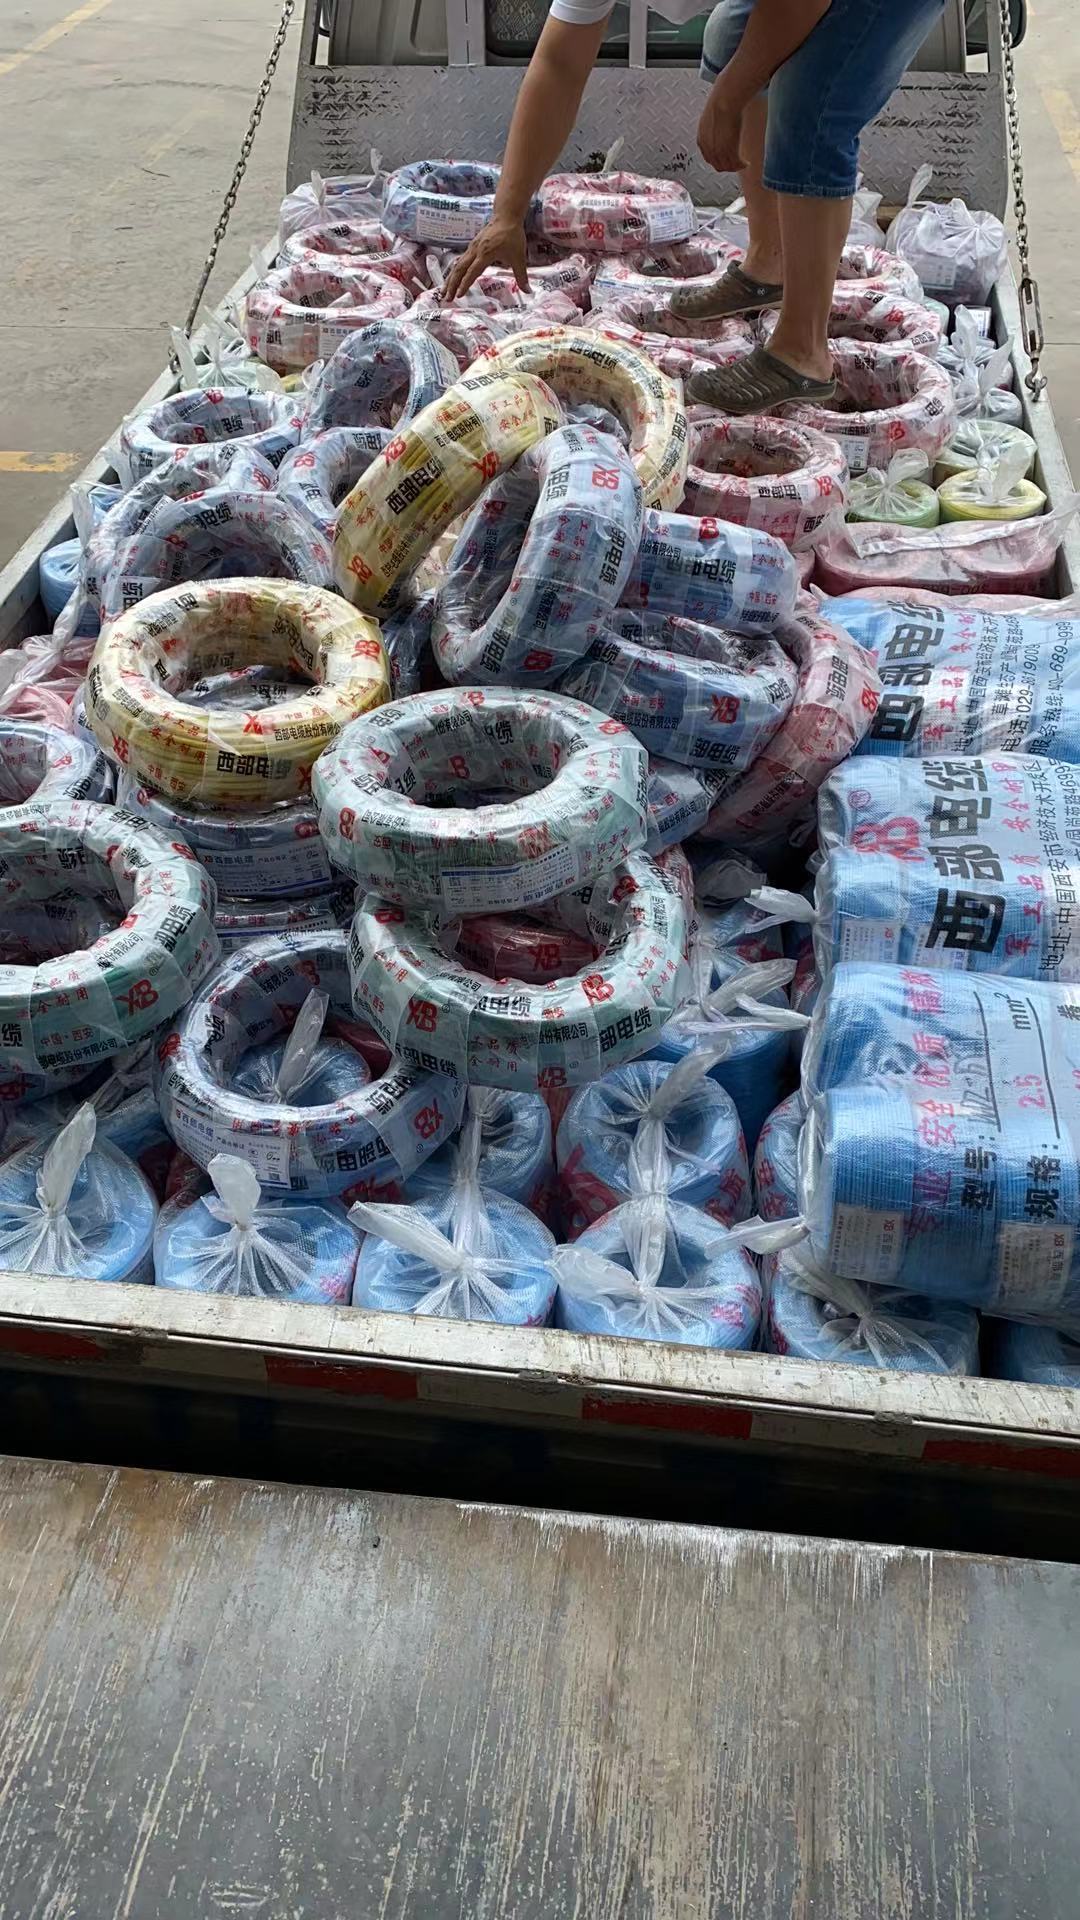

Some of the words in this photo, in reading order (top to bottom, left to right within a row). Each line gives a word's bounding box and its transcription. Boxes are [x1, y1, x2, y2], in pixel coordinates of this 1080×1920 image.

[592, 464, 620, 490] XB
[709, 693, 742, 724] XB
[921, 759, 1006, 954] 西部电缆
[114, 979, 160, 1017] XB
[405, 996, 438, 1033] XB
[600, 1006, 652, 1053] 部电缆
[1024, 1144, 1061, 1219] 规格:
